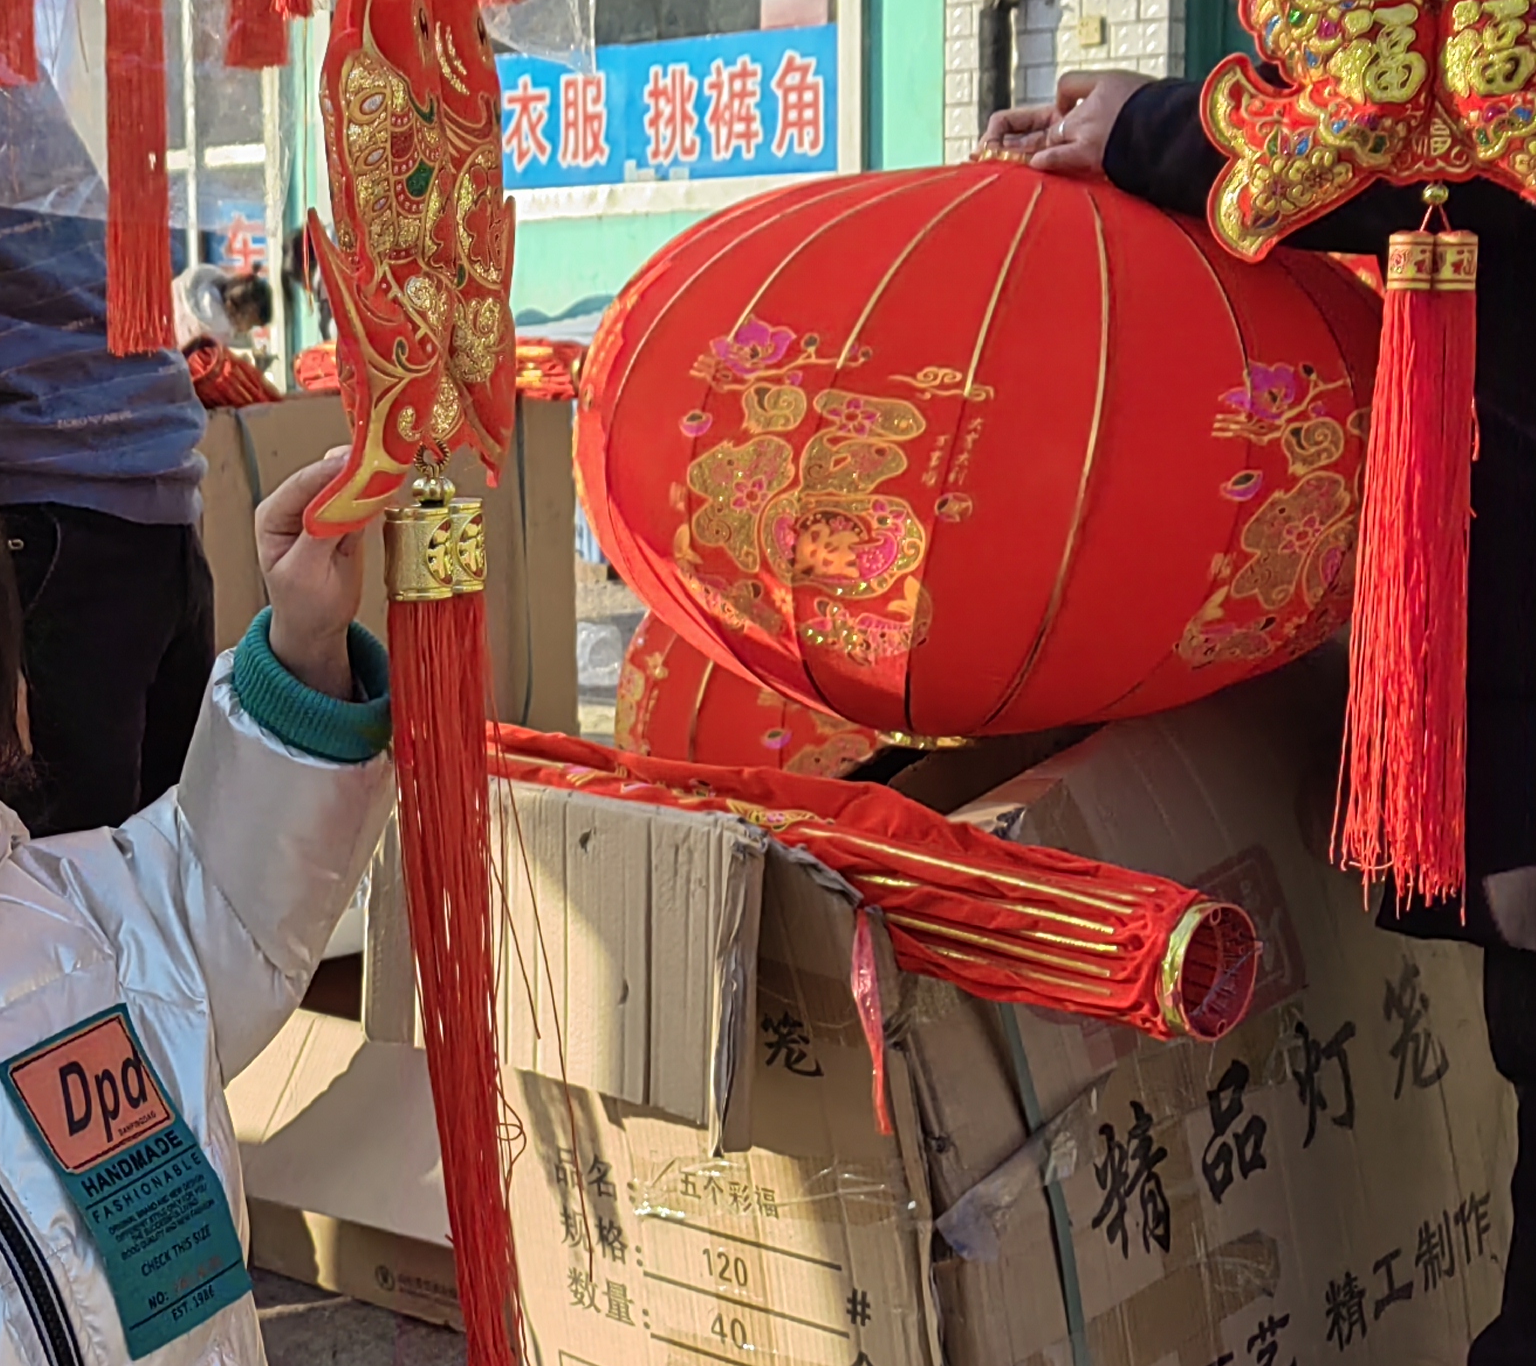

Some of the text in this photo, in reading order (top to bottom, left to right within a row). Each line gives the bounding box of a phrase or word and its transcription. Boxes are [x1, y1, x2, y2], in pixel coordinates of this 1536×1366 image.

[1327, 3, 1428, 104] 福
[504, 50, 825, 165] 衣服 挑裤角
[58, 1055, 148, 1143] Dpd
[1092, 961, 1449, 1259] 精品灯笼
[80, 1129, 184, 1197] HANDMADE
[92, 1151, 202, 1223] FASHIONABLE
[680, 1172, 781, 1220] 五个彩福
[141, 1249, 171, 1277] CHECK
[171, 1237, 193, 1258] THIS
[192, 1224, 213, 1246] SIZE
[702, 1247, 749, 1287] 120
[1325, 1191, 1492, 1352] 精工制作
[710, 1312, 748, 1350] 40
